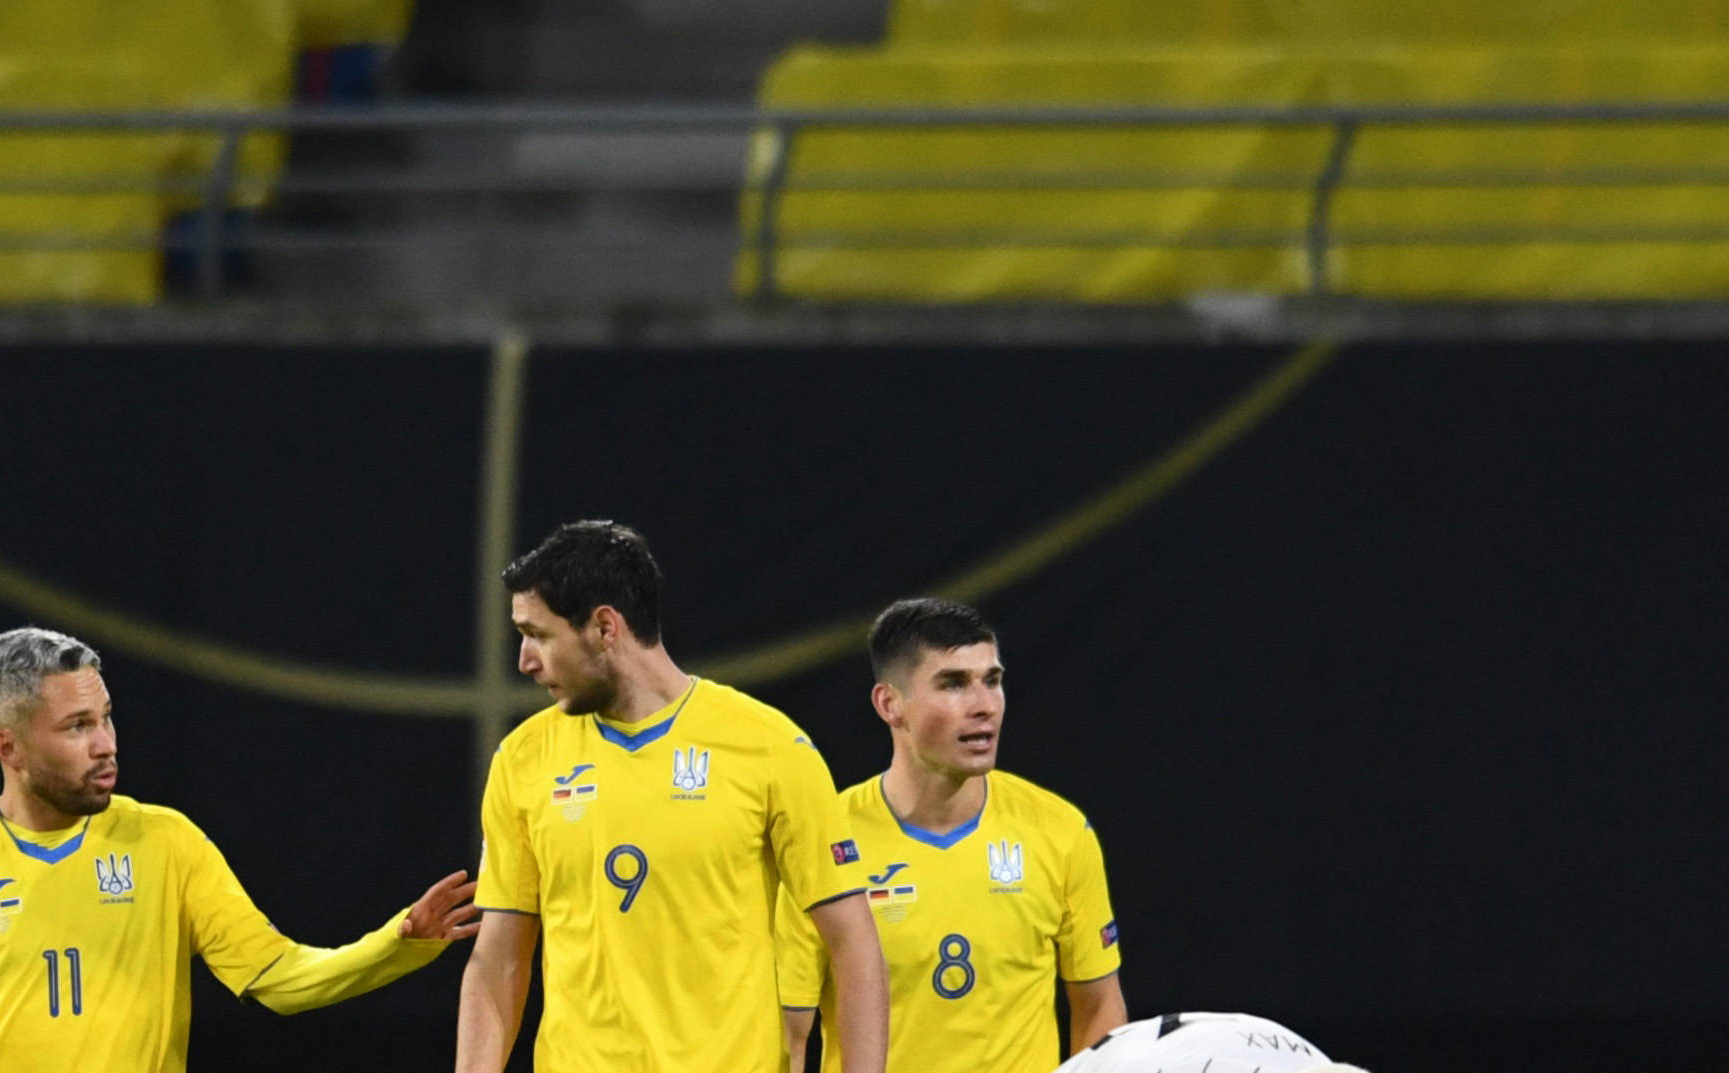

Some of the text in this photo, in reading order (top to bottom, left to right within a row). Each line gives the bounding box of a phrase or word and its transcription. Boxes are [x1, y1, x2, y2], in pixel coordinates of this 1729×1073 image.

[604, 844, 648, 913] 9
[42, 948, 83, 1018] 11
[932, 933, 976, 1000] 8
